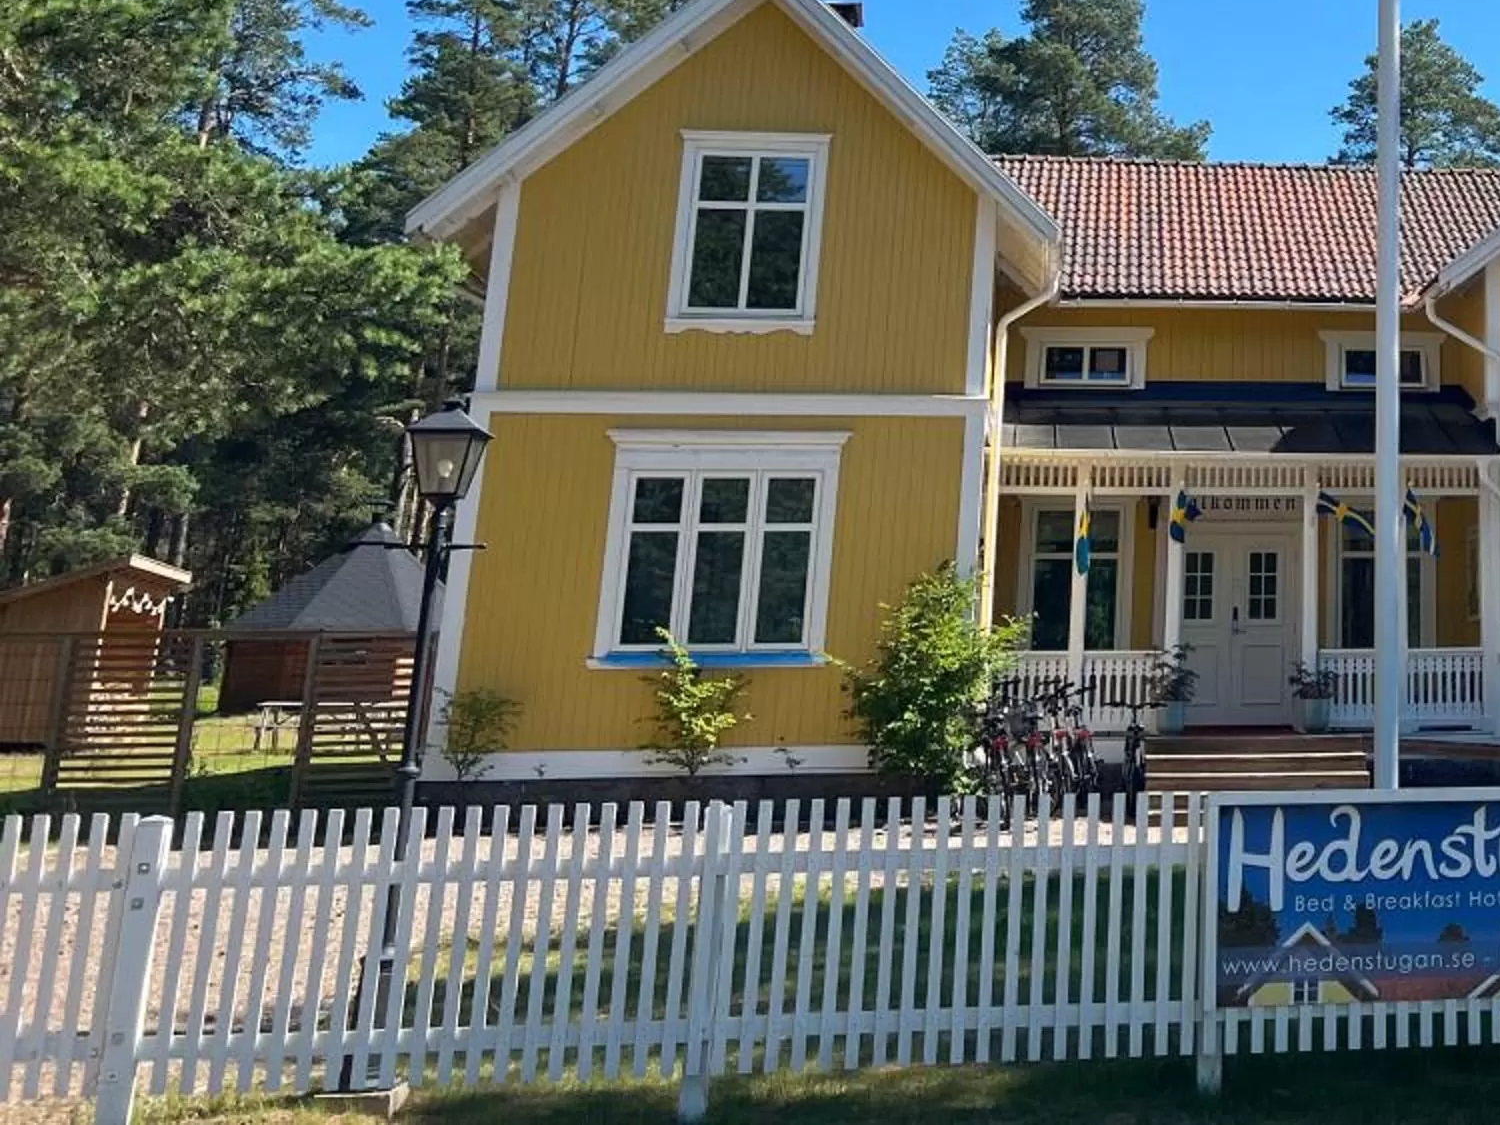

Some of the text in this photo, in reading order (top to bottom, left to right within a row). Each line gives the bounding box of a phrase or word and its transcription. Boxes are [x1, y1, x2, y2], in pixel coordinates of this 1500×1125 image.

[1187, 495, 1297, 510] lkommen
[1294, 894, 1335, 913] Bed
[1343, 894, 1357, 912] &
[1365, 891, 1461, 913] Breakfast
[1222, 949, 1476, 975] www.hedenstugan.se
